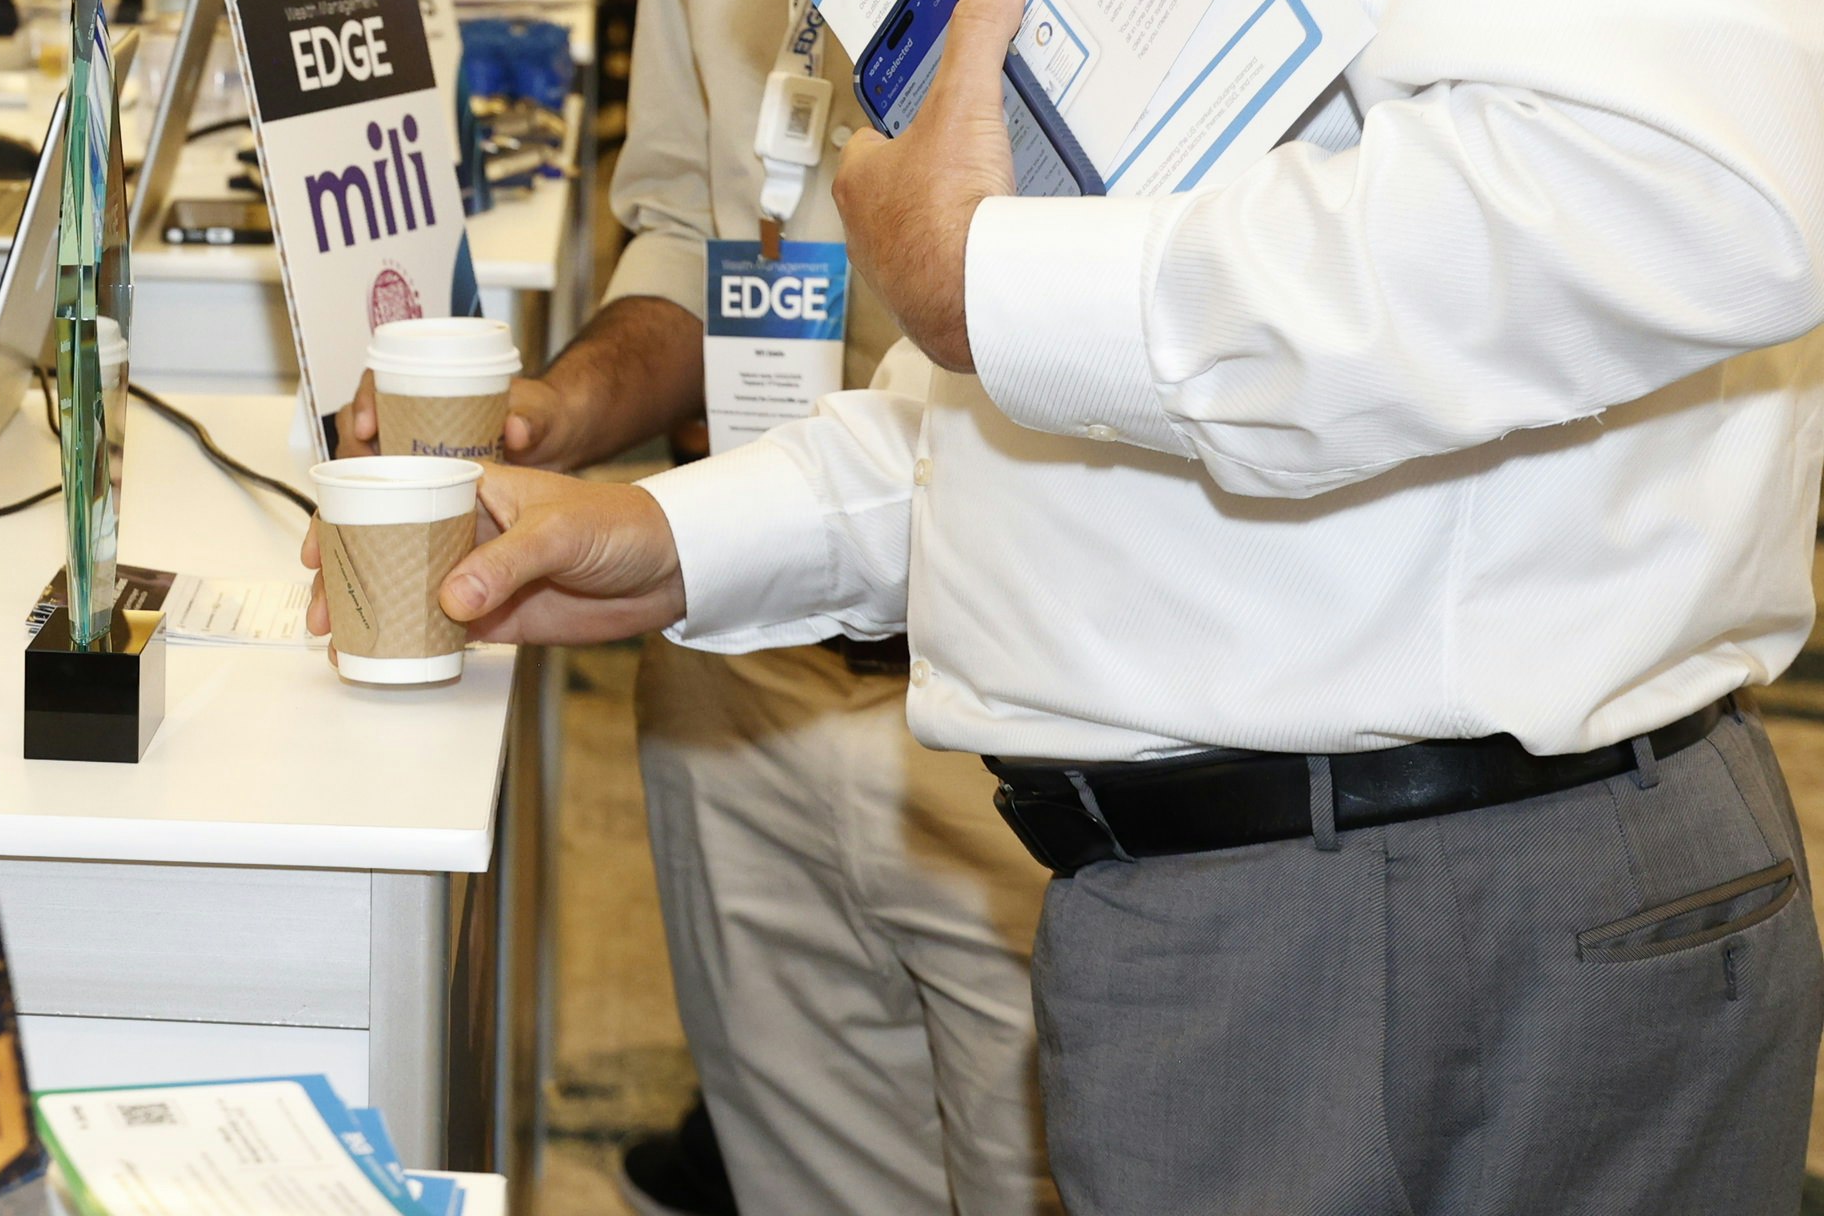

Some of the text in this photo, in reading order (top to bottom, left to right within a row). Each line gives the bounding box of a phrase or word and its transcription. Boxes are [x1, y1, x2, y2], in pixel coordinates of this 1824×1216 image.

[792, 3, 825, 55] EDG
[289, 15, 394, 93] EDGE
[883, 36, 915, 79] Selected
[880, 75, 889, 84] 1
[305, 113, 436, 254] mili
[721, 275, 830, 321] EDGE
[411, 438, 495, 458] Federated
